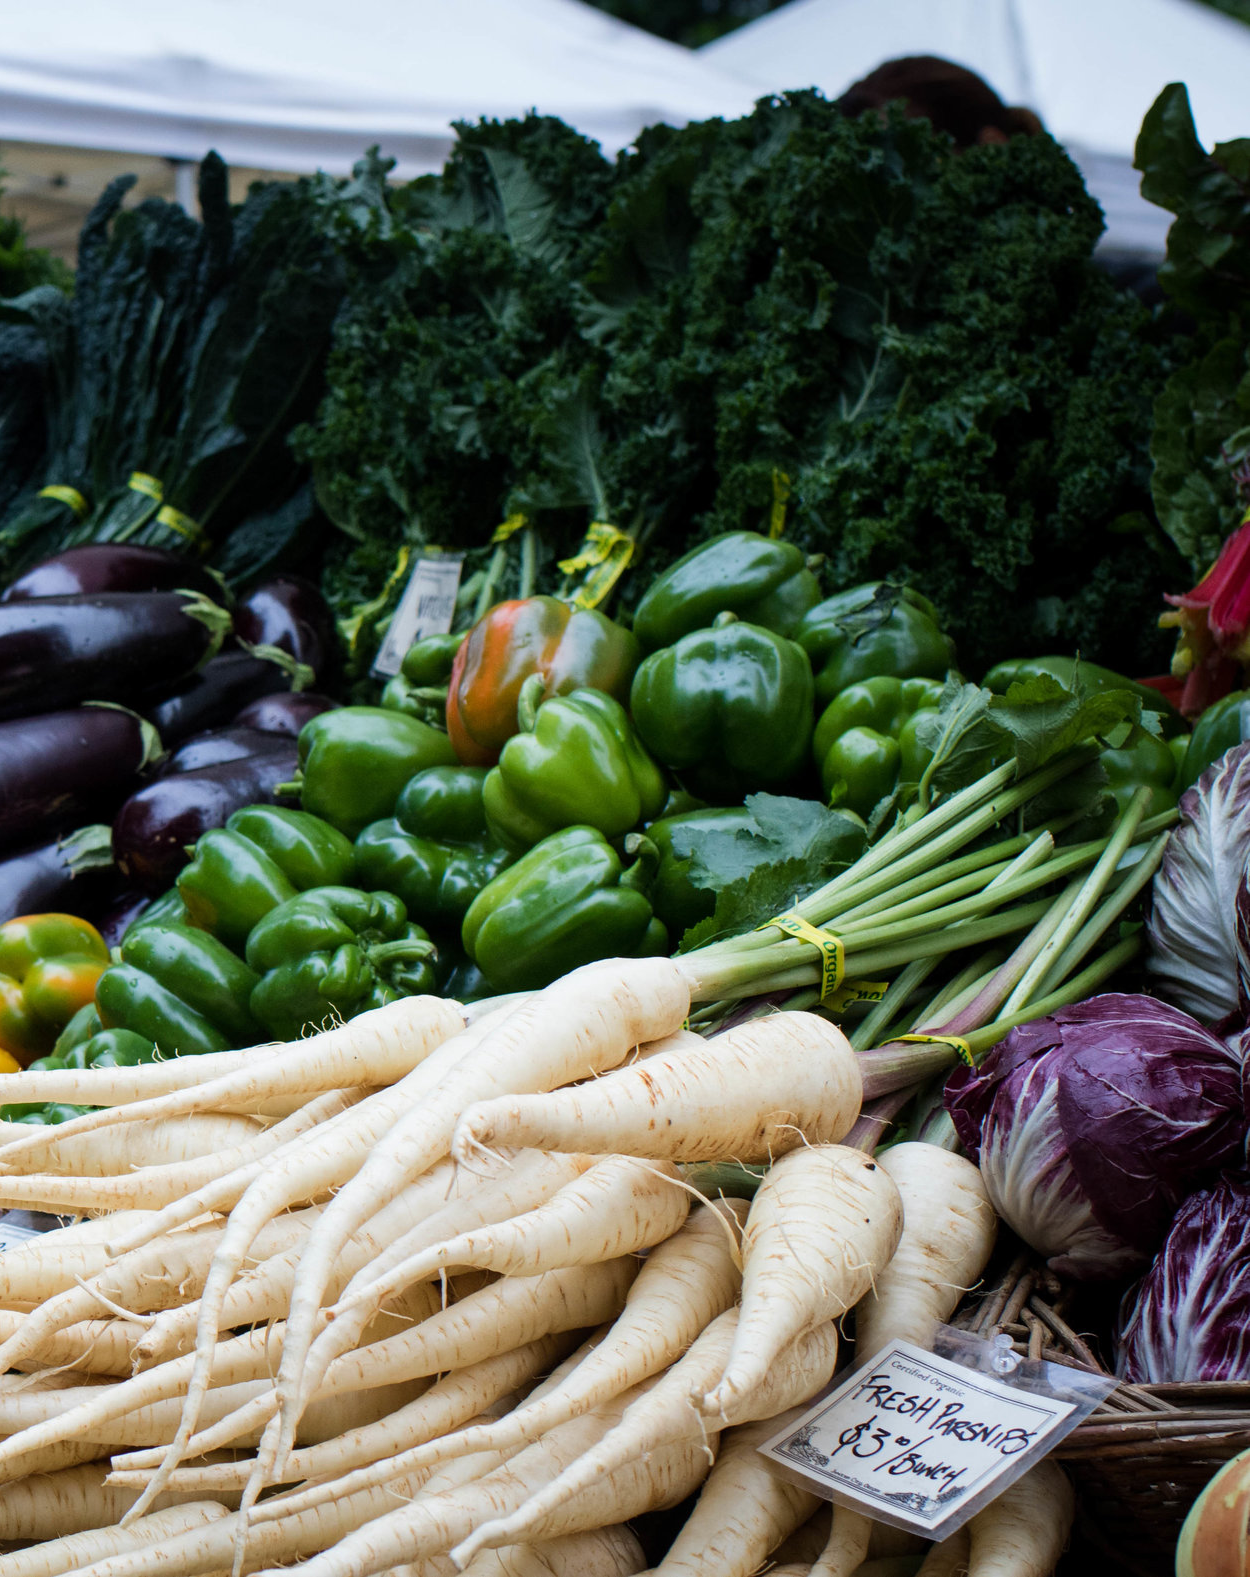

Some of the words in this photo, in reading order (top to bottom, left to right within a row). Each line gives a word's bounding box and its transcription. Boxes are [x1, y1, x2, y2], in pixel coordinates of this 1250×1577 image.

[823, 941, 838, 995] Organ
[852, 1375, 940, 1424] FRESH
[891, 1360, 932, 1382] Certified
[929, 1377, 966, 1398] Organic
